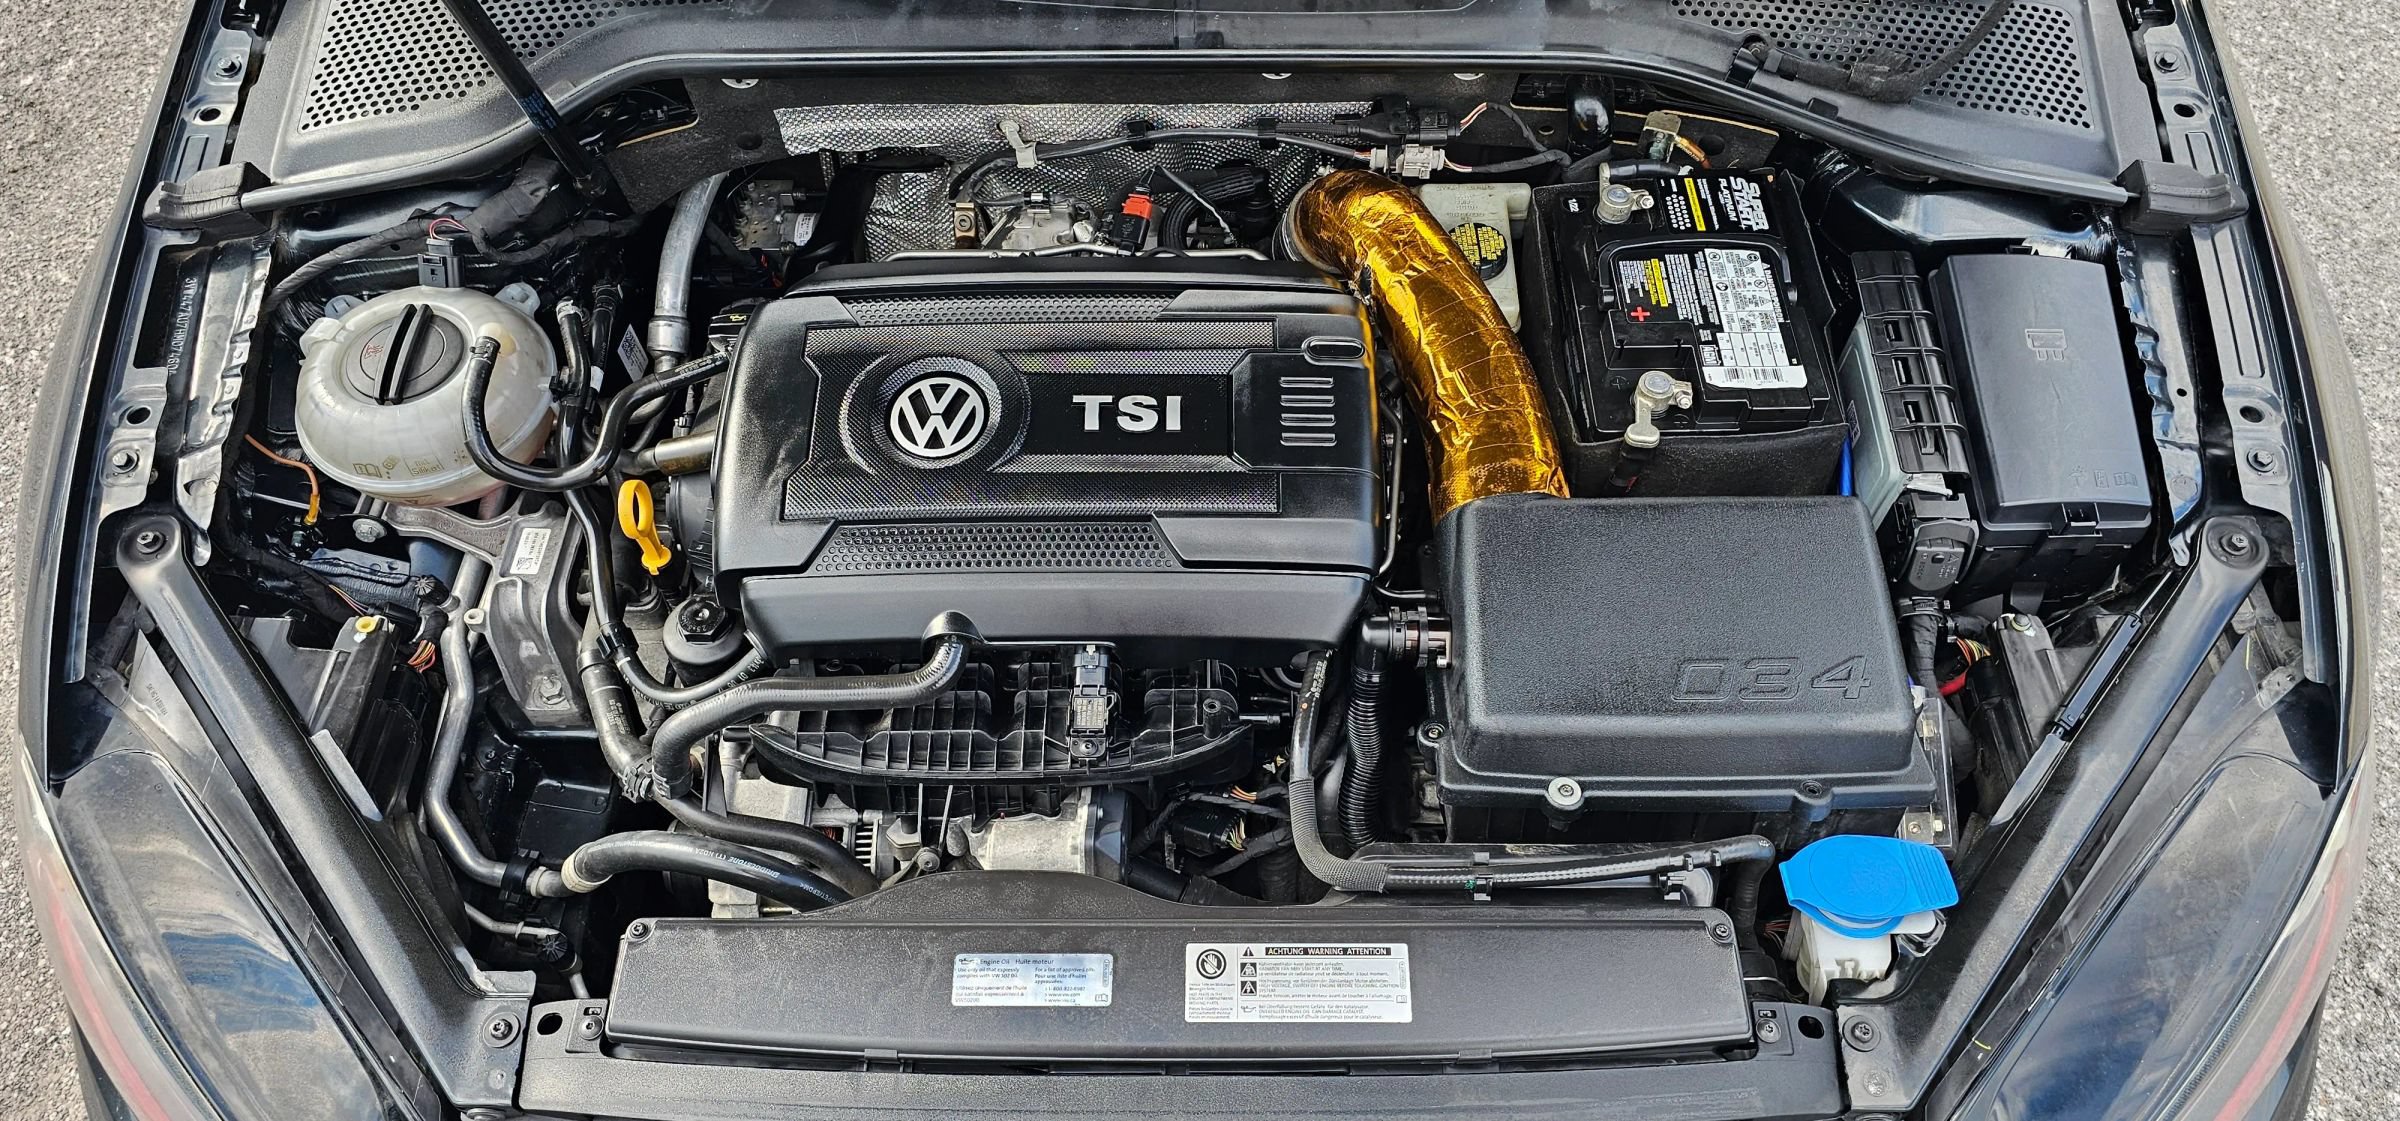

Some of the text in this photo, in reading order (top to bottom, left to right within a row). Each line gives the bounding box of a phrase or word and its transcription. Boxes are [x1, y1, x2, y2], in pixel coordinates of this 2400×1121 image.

[1718, 178, 1738, 222] PLATINUM
[1729, 176, 1758, 231] START
[1745, 182, 1769, 230] SUPER
[1072, 395, 1182, 431] TSI
[1671, 655, 1871, 701] 034
[715, 852, 727, 861] (T)
[727, 855, 780, 878] BRIDGESTONE
[980, 959, 1000, 967] Engine
